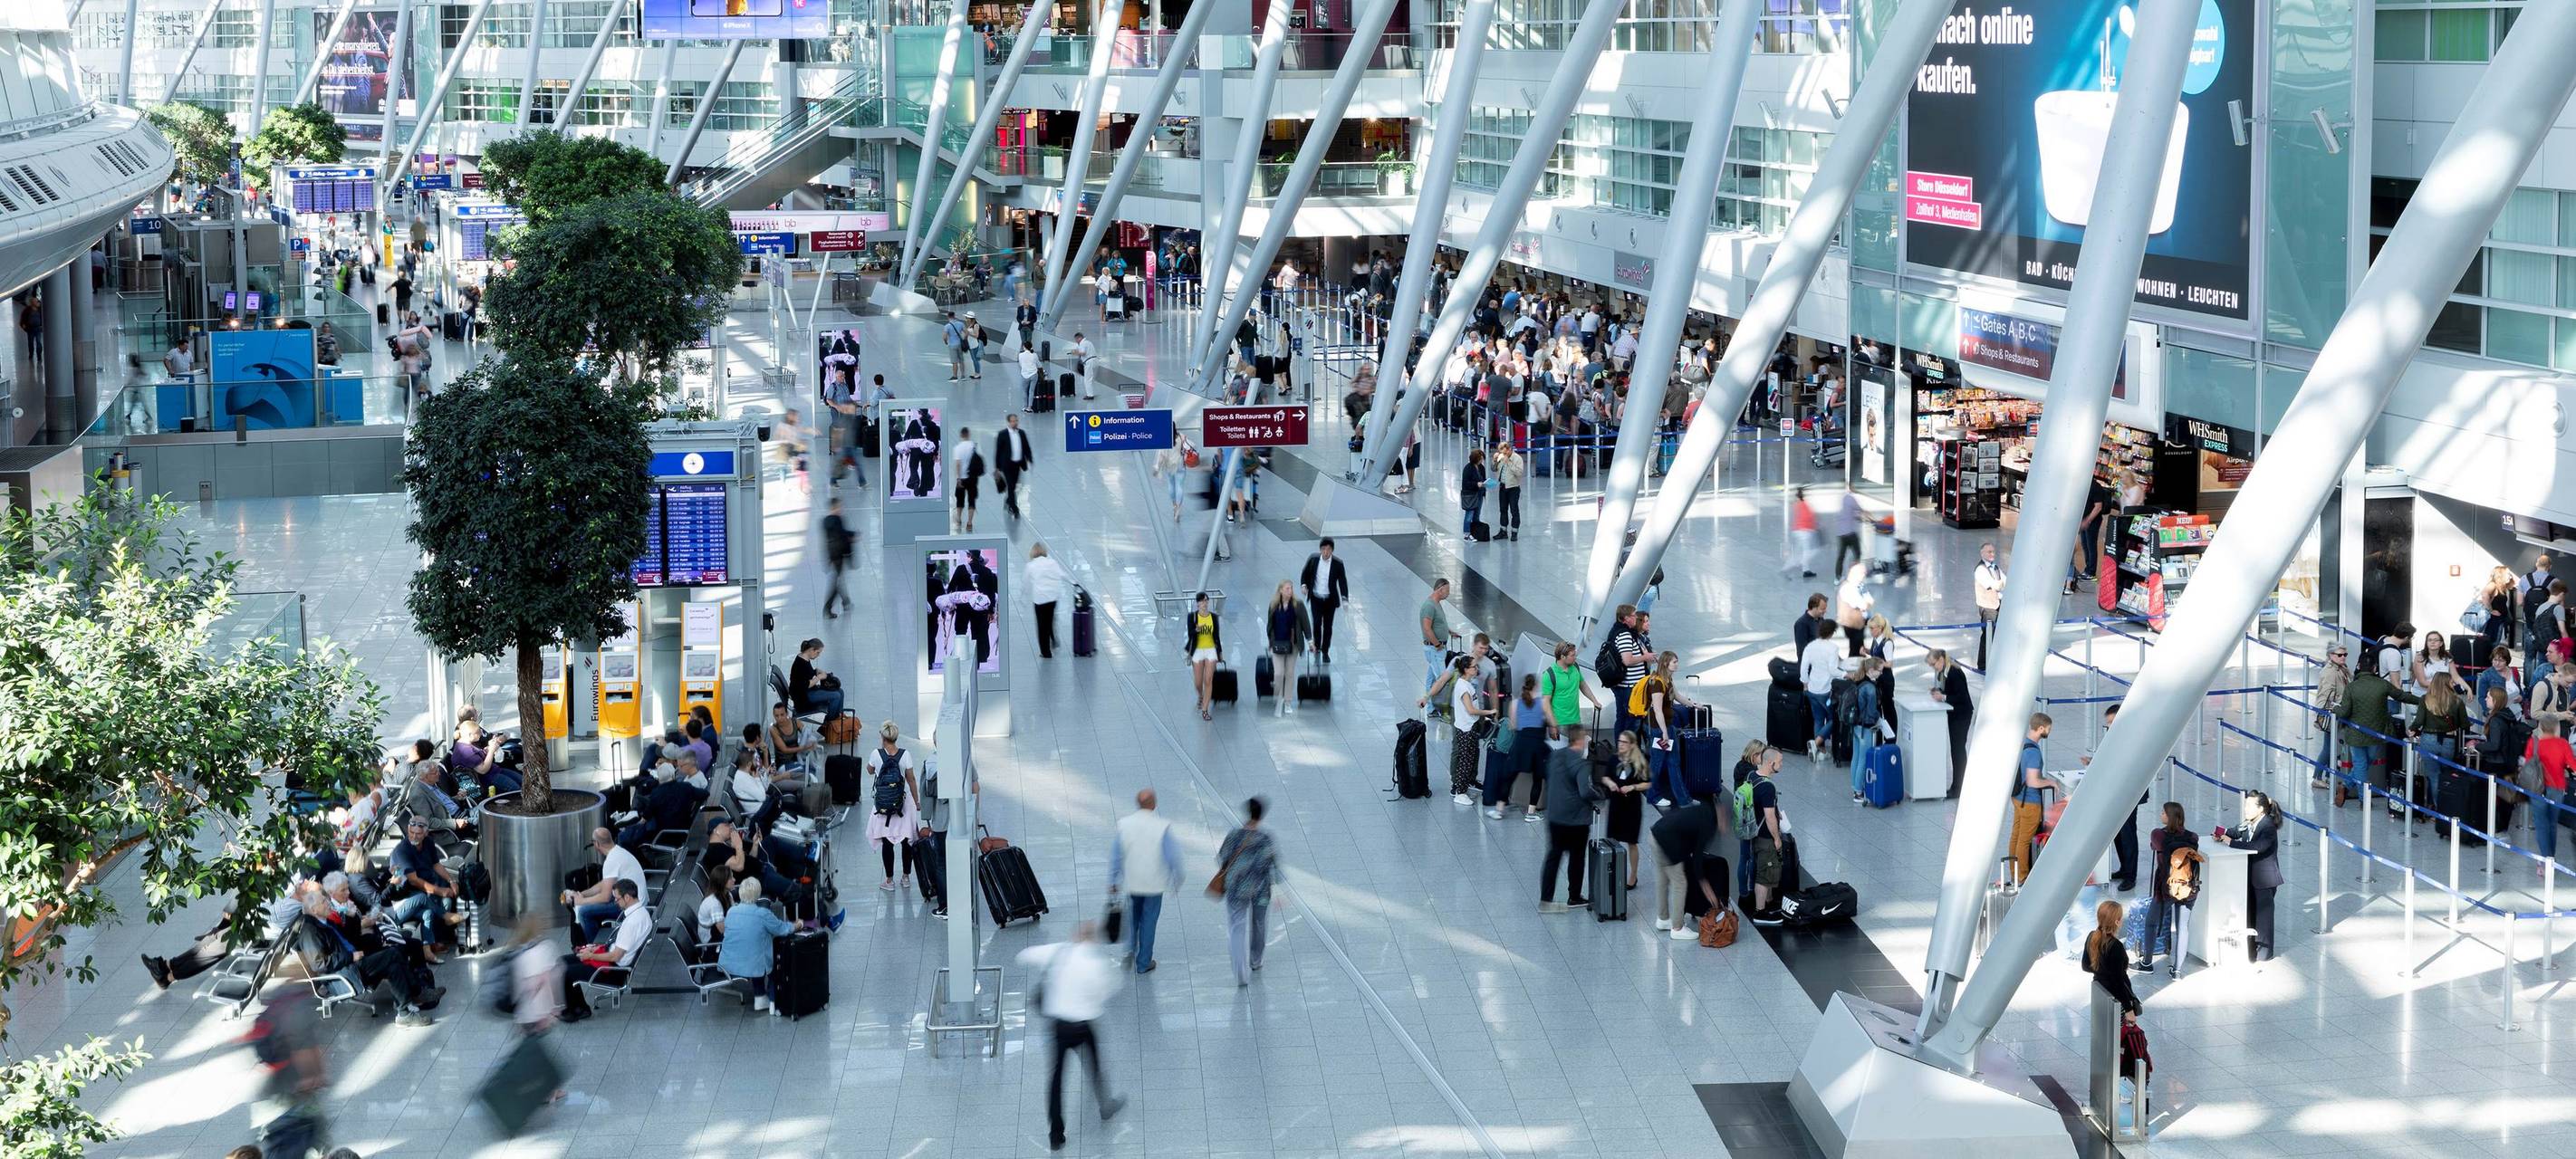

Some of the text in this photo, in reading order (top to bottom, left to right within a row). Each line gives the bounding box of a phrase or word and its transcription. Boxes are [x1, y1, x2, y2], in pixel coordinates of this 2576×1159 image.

[1981, 6, 2033, 44] online
[1918, 56, 1976, 94] kaufen.
[1917, 178, 1968, 196] Store Düsseldorf
[1916, 203, 1935, 217] Zollhof
[1942, 206, 1977, 223] Medienhafen
[149, 220, 161, 229] 10
[294, 240, 301, 249] P
[2026, 261, 2043, 276] BAD
[2052, 263, 2078, 283] KÜCH
[2137, 278, 2177, 298] WOHNEN
[2188, 285, 2238, 309] LEUCHTEN
[1981, 315, 2036, 343] Gates A,B,C
[1916, 354, 1944, 371] WHSmith
[1980, 344, 2039, 369] Shops & Restaurants
[1927, 369, 1944, 379] EXPRESS
[1103, 416, 1145, 425] Information
[1209, 414, 1228, 422] Shops
[1235, 412, 1271, 420] Restaurants
[1103, 432, 1127, 441] Polizei
[1132, 432, 1152, 440] Police
[2188, 420, 2228, 443] WHSmith
[2204, 439, 2228, 452] EXPRESS
[591, 668, 599, 722] Eurowings
